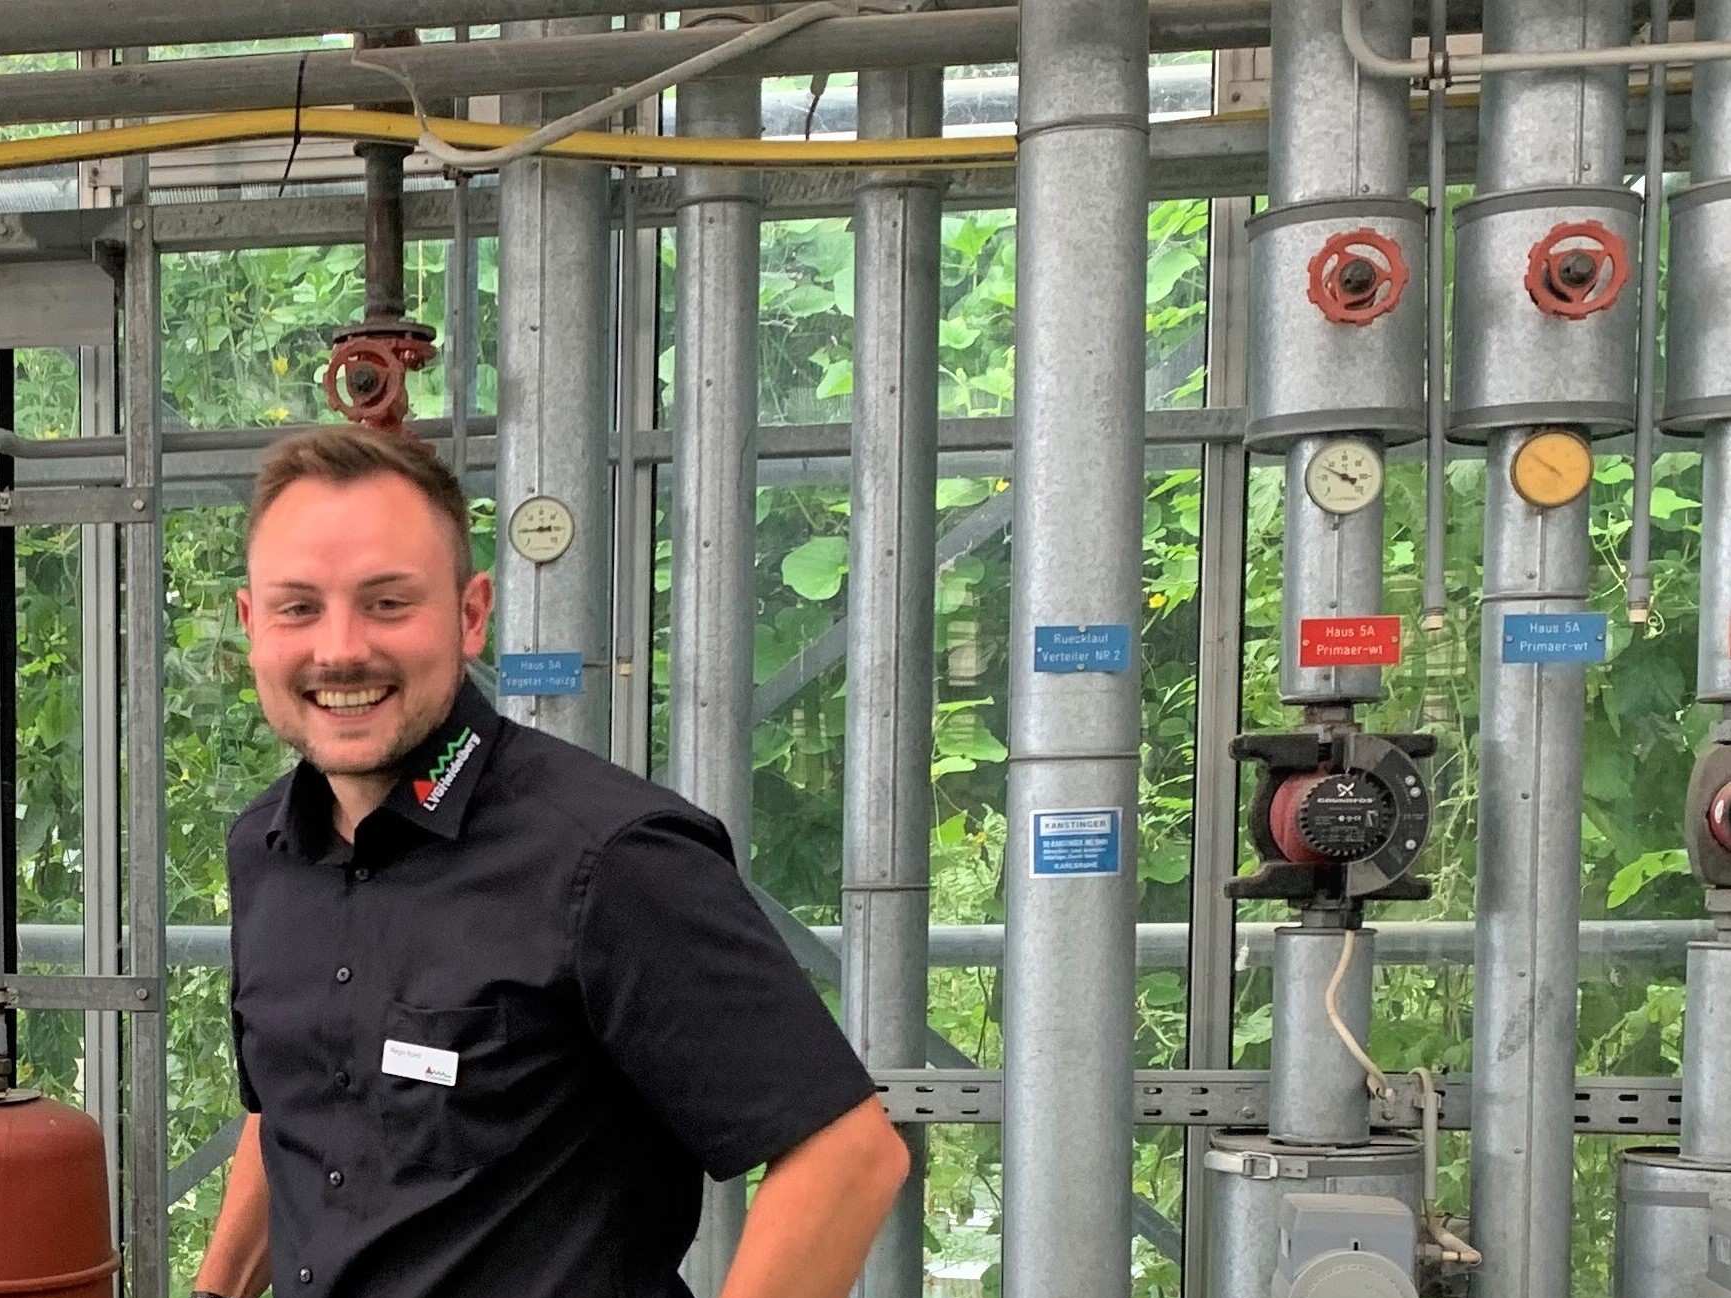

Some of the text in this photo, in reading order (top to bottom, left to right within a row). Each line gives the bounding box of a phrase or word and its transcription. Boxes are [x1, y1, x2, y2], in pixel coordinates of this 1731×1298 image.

[1325, 626, 1375, 637] Haus 5A
[1529, 622, 1580, 634] Haus 5A
[1316, 644, 1383, 656] Primaer-wt
[1520, 641, 1589, 653] Primaer-wt
[1041, 650, 1090, 662] Verteiler
